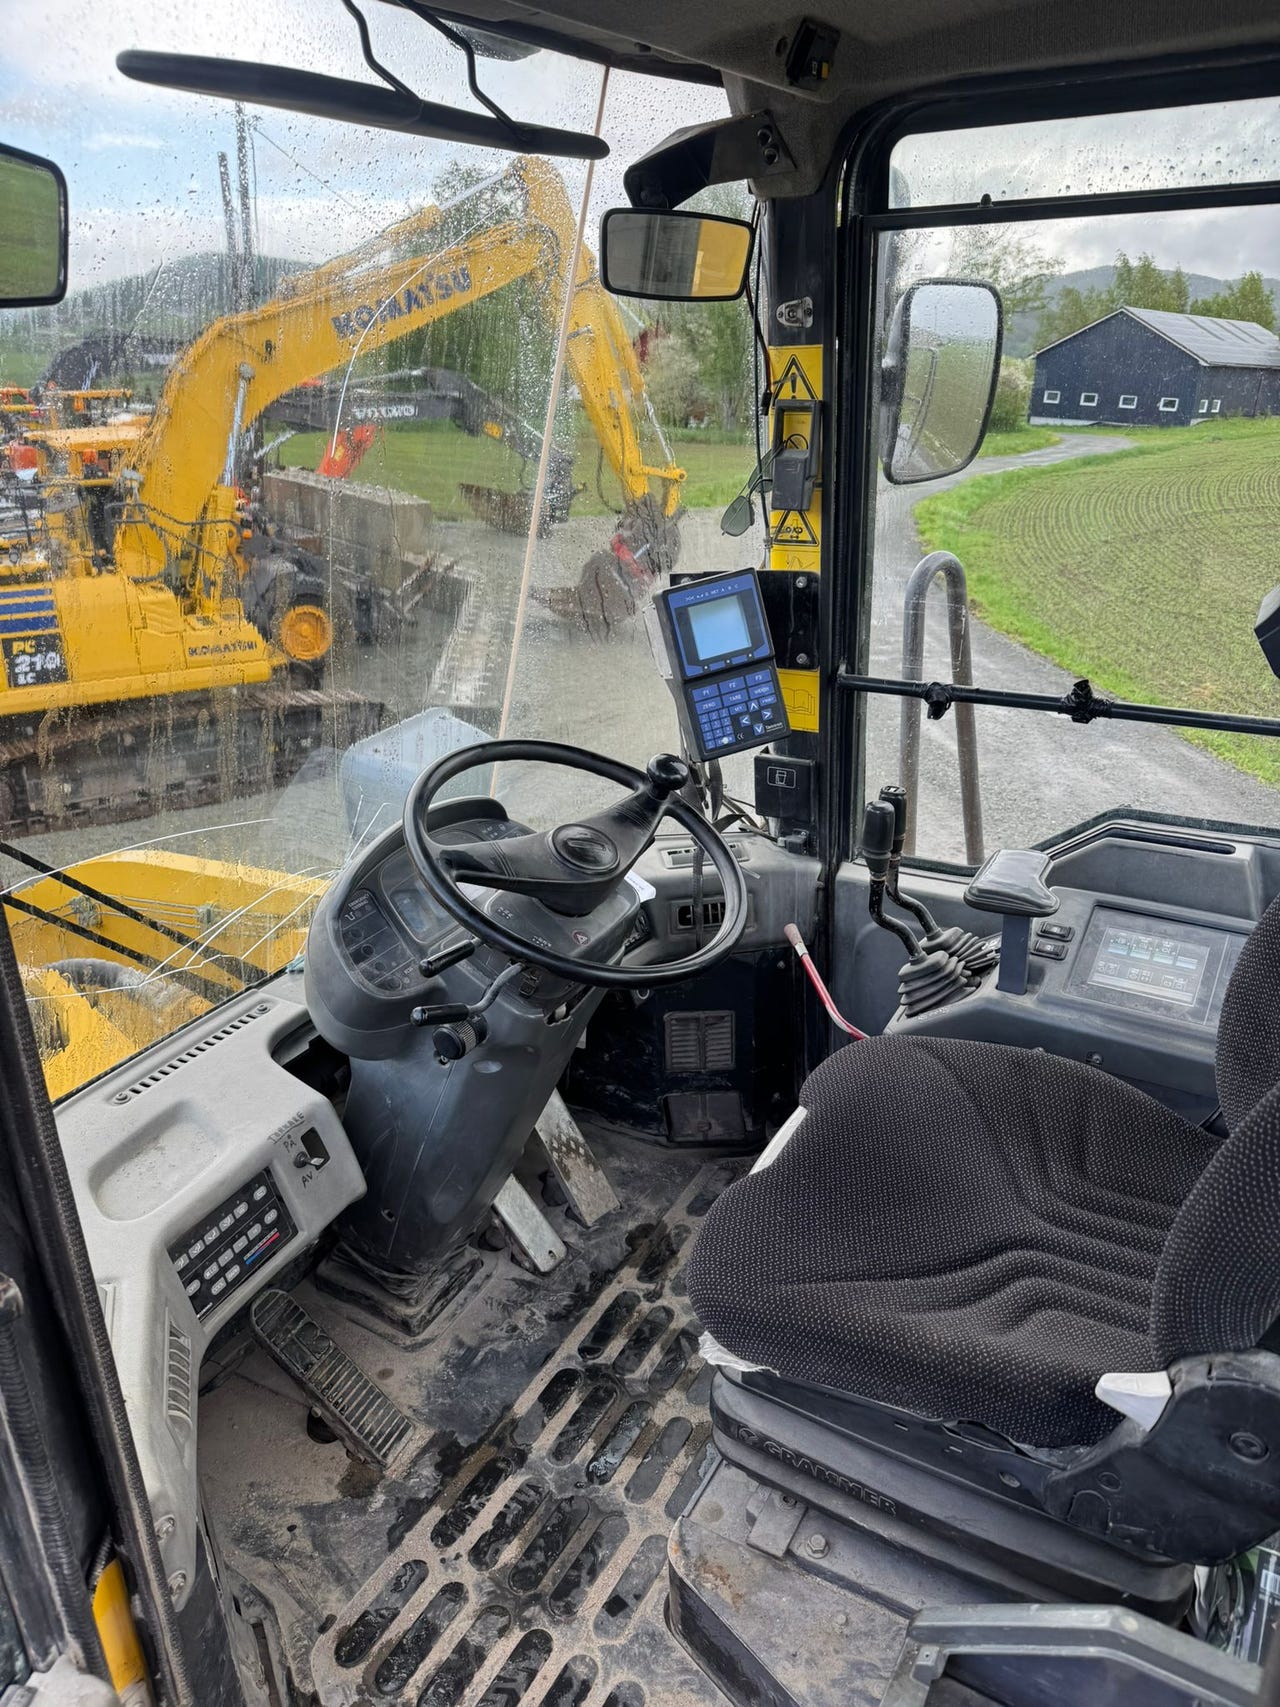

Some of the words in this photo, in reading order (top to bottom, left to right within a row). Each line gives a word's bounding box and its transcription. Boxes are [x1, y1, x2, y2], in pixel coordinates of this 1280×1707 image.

[12, 639, 36, 655] PC
[301, 1170, 313, 1188] AV
[763, 1441, 897, 1517] GRAMMER
